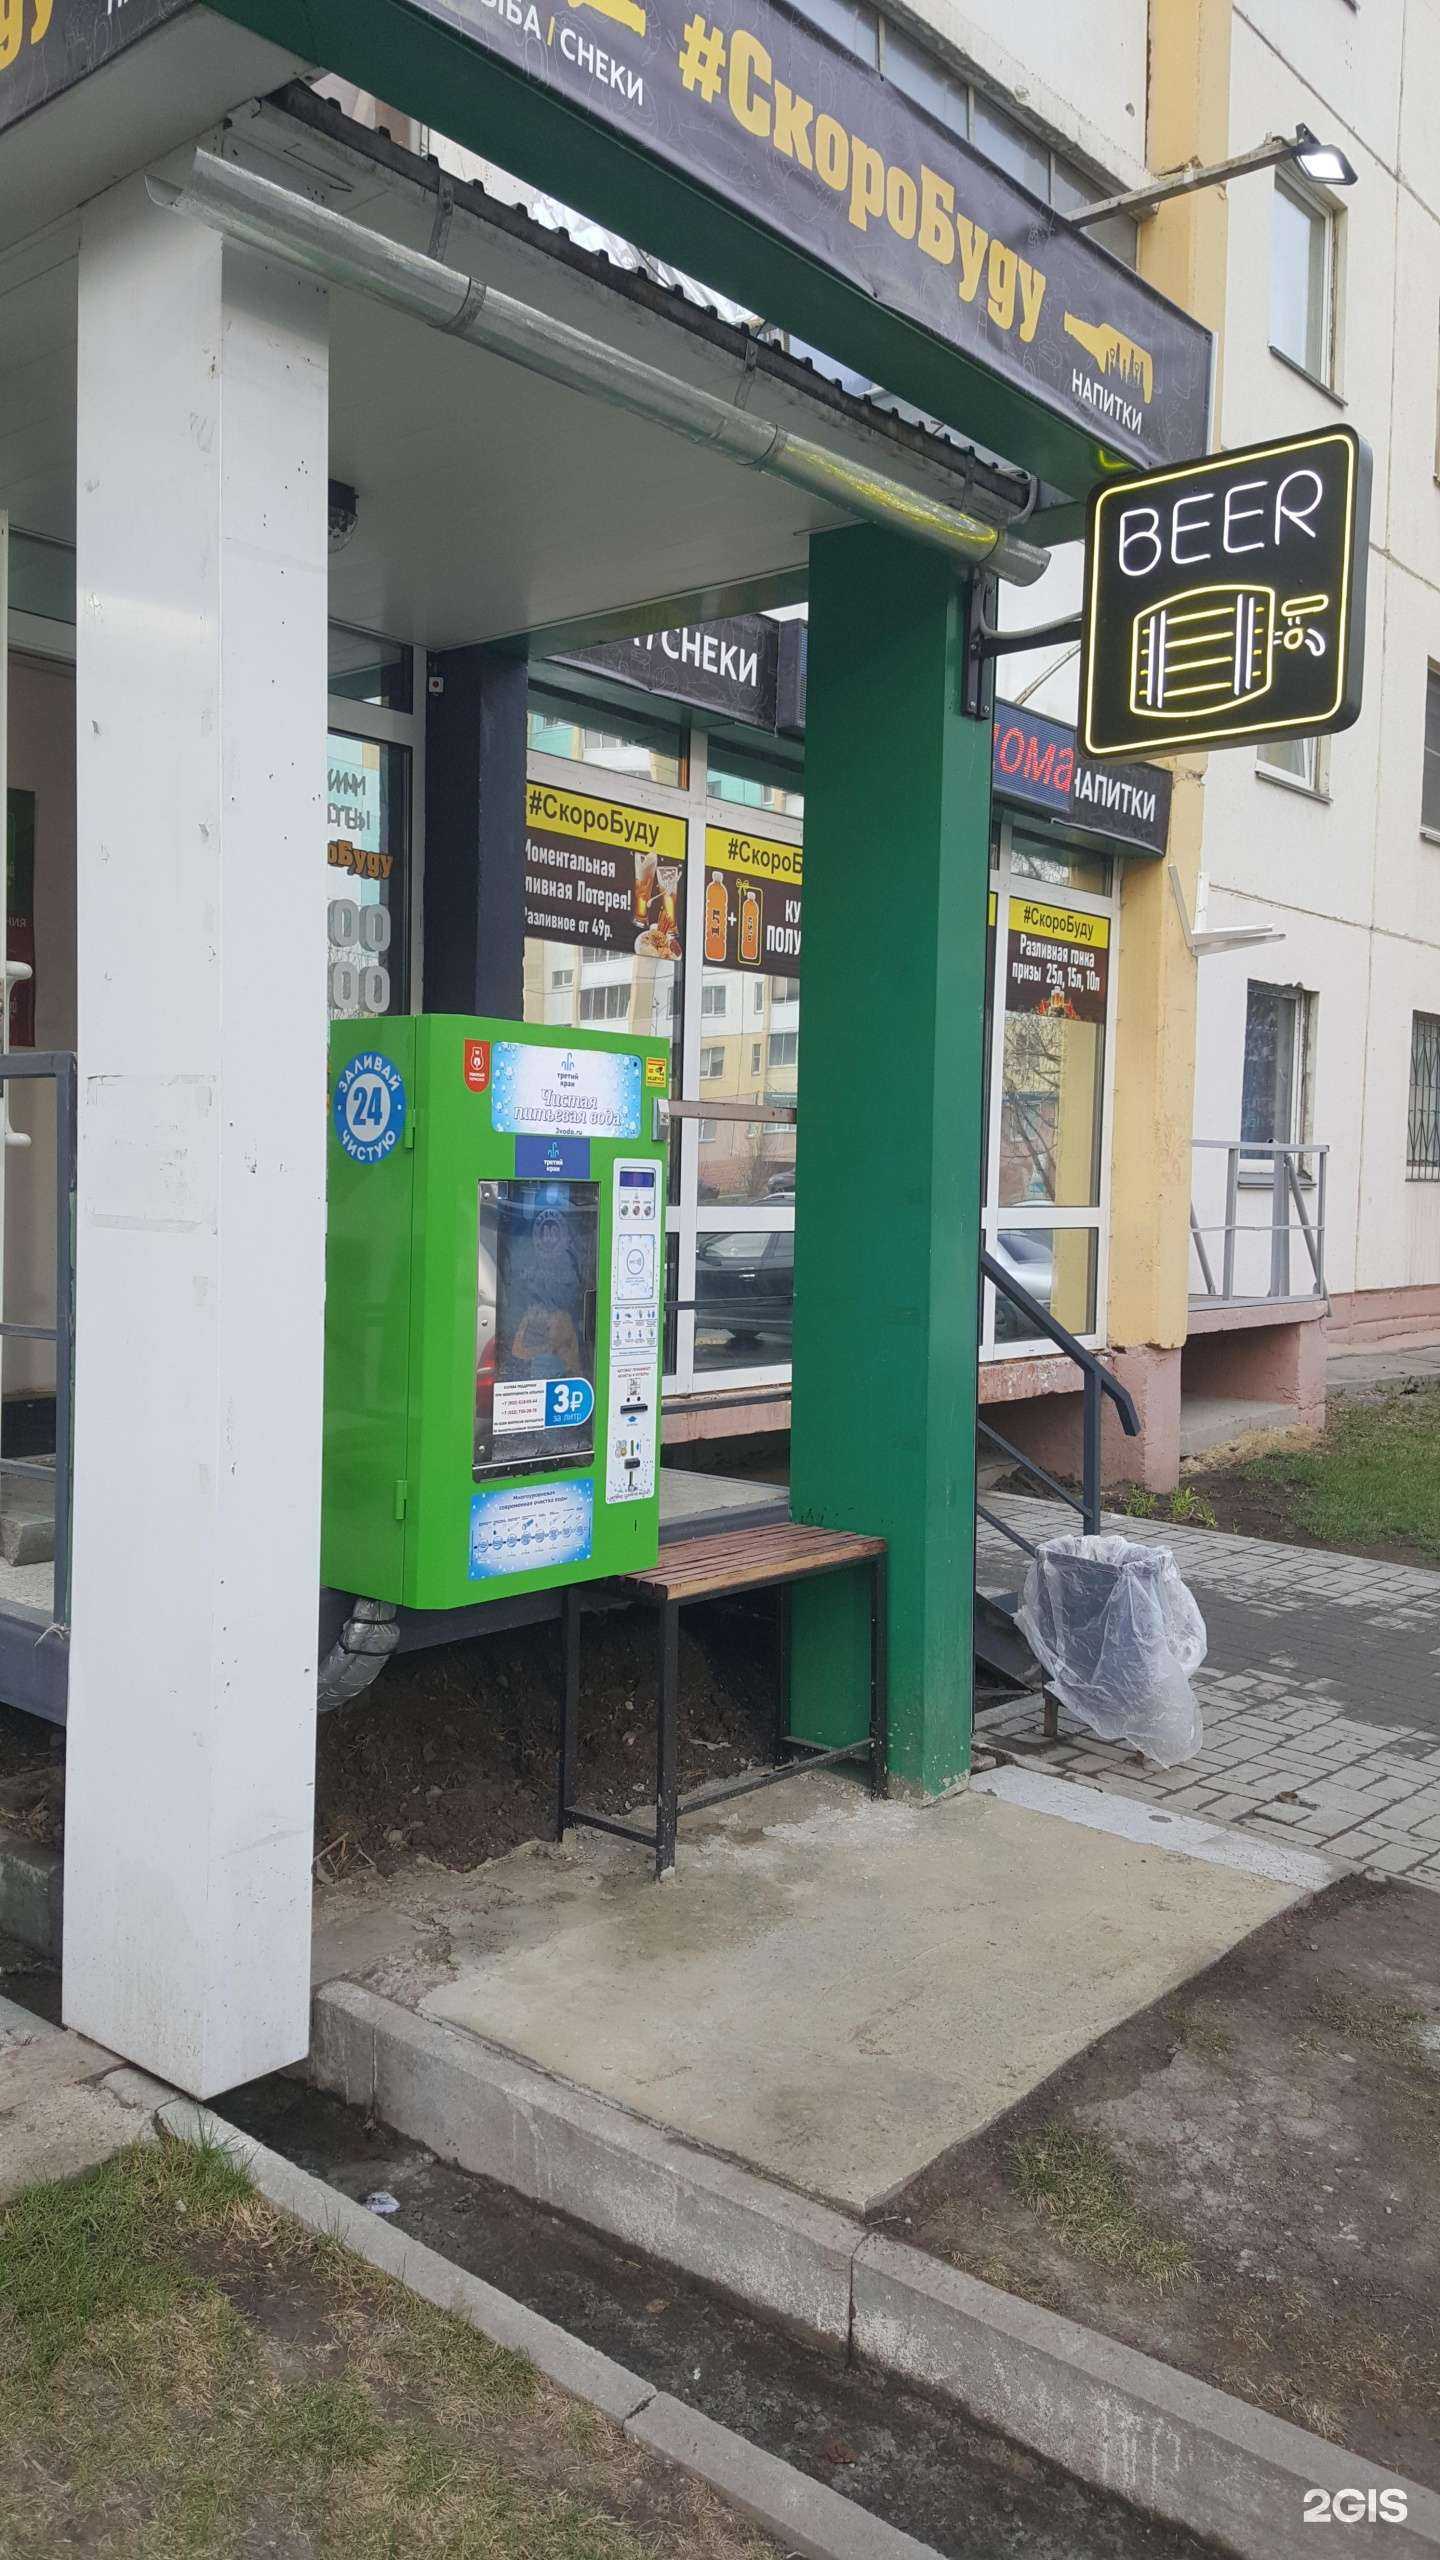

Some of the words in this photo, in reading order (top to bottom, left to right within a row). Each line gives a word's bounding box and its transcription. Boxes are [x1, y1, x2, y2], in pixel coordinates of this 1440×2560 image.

[560, 28, 643, 106] СНЕКИ
[679, 14, 1047, 343] #СкороБуду
[1072, 367, 1143, 435] НАПИТКИ
[1119, 470, 1323, 576] BEER
[661, 627, 758, 687] СНЕКИ
[993, 724, 1074, 792] ома
[529, 790, 659, 847] #СкороБуду
[525, 876, 572, 900] пивная
[576, 880, 632, 913] Лотерея!
[525, 906, 576, 932] азливное
[579, 922, 590, 933] от
[592, 918, 613, 941] 49р.
[1023, 905, 1094, 941] #СкороБуду
[1020, 934, 1068, 963] Разливная
[1070, 949, 1095, 967] гонка
[1012, 962, 1042, 984] призы
[1046, 963, 1065, 989] 25л,
[1086, 970, 1100, 991] 10л
[339, 1055, 402, 1092] ЗАЛИВАЙ
[557, 1072, 579, 1081] третий
[353, 1086, 383, 1126] 24
[514, 1106, 587, 1125] питьевая
[588, 1110, 622, 1127] вода
[541, 1088, 598, 1110] Чистая
[342, 1130, 396, 1161] ЧИСТУЮ
